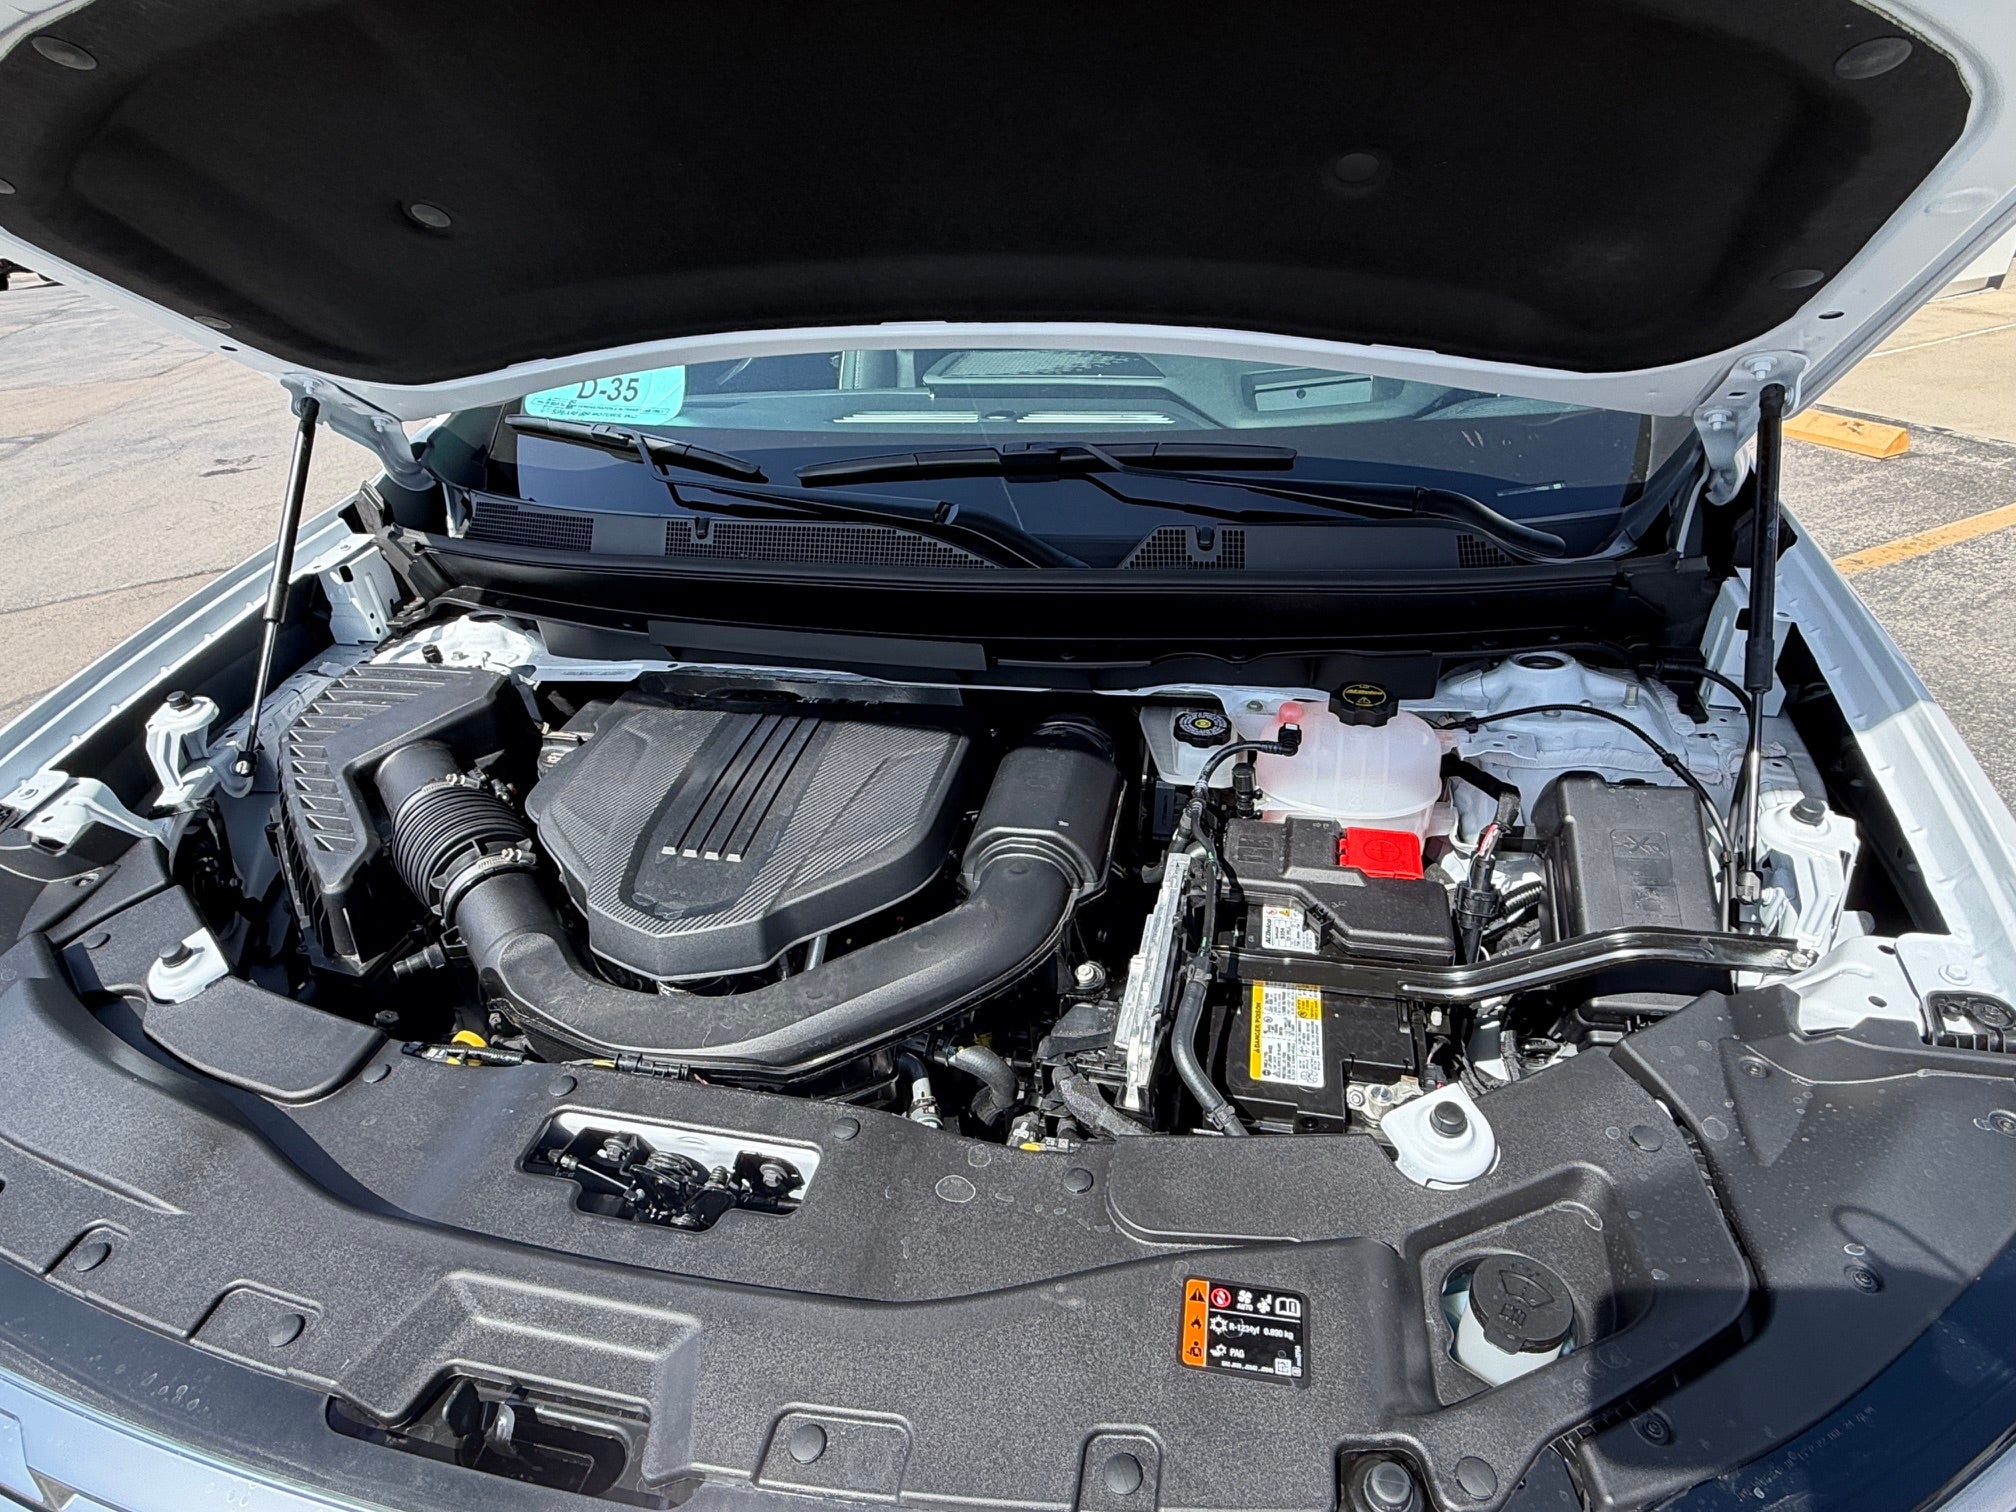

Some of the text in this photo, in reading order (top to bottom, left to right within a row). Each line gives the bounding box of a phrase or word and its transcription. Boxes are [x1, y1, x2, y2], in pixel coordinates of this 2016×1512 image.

[576, 377, 640, 402] D-35
[1236, 1303, 1254, 1312] AUTO
[1284, 1329, 1294, 1340] kg
[1229, 1348, 1245, 1359] PAG
